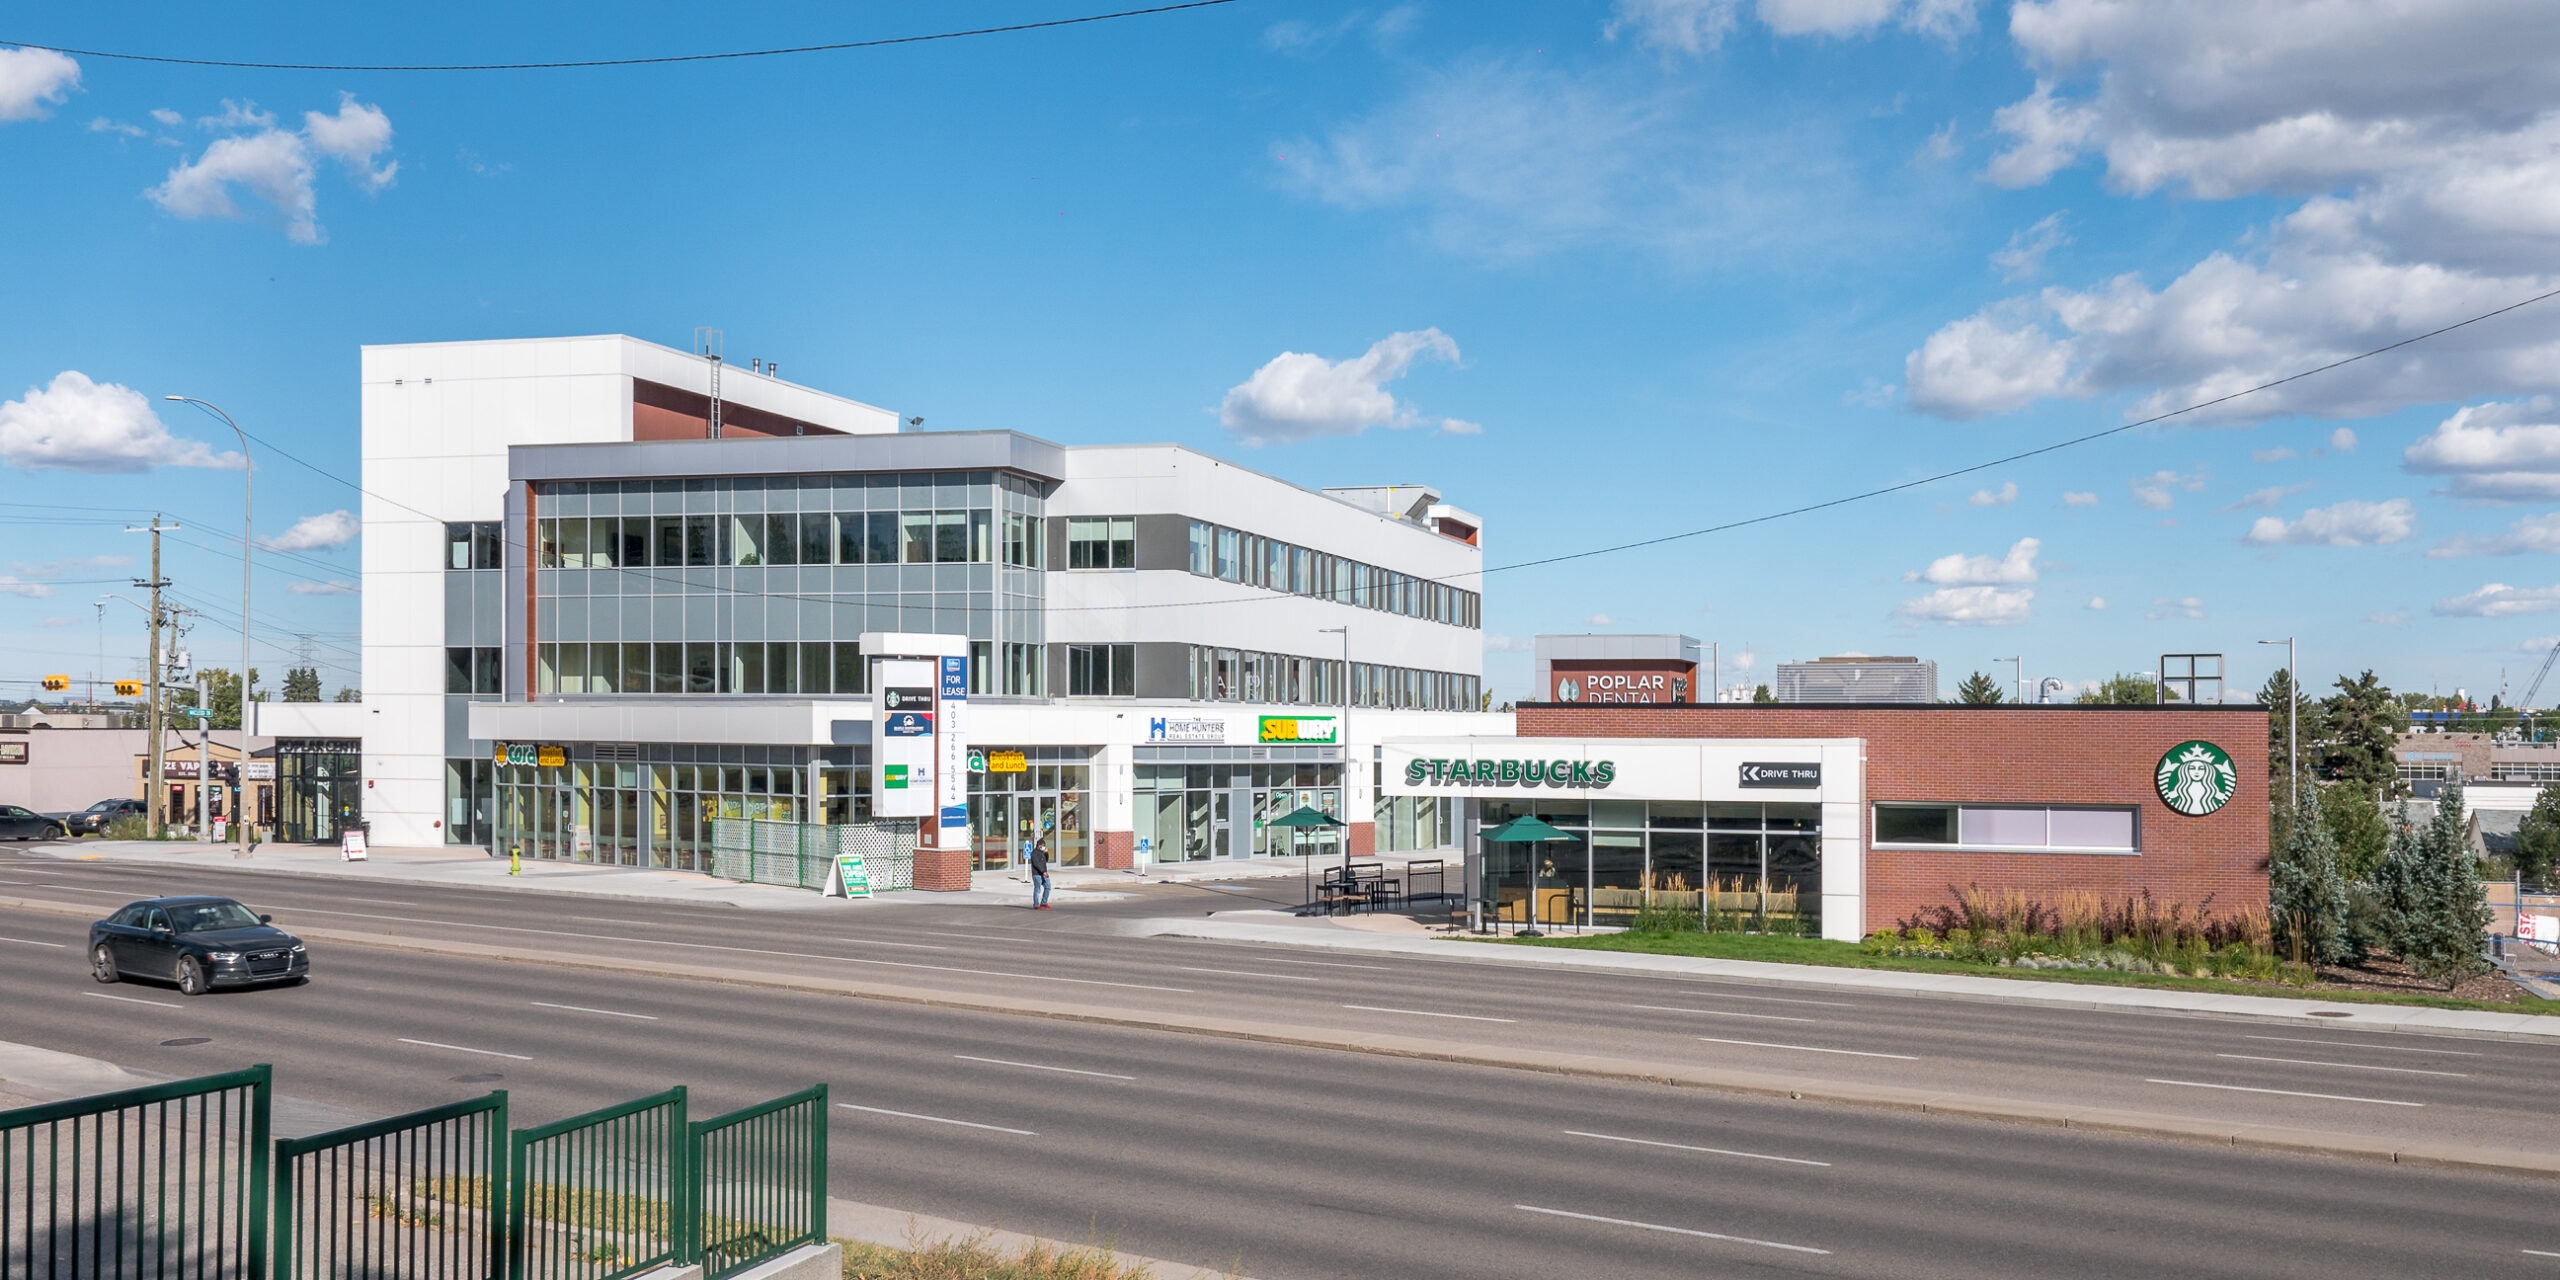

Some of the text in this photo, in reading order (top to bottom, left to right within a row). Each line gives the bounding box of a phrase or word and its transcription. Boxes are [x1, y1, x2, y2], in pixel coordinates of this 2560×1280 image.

[946, 675, 961, 684] FOR
[1587, 675, 1664, 690] POPLAR
[942, 687, 966, 696] LEASE
[1169, 723, 1225, 733] HOME HUNTERS
[1261, 718, 1337, 741] SUBWAY
[508, 744, 537, 766] cora
[991, 752, 1022, 760] Breakfast
[180, 761, 201, 770] VAP
[991, 761, 1026, 769] and Lunch
[1408, 758, 1616, 784] STARBUCKS
[1760, 769, 1818, 779] DRIVE THRU
[845, 870, 865, 878] OPEN
